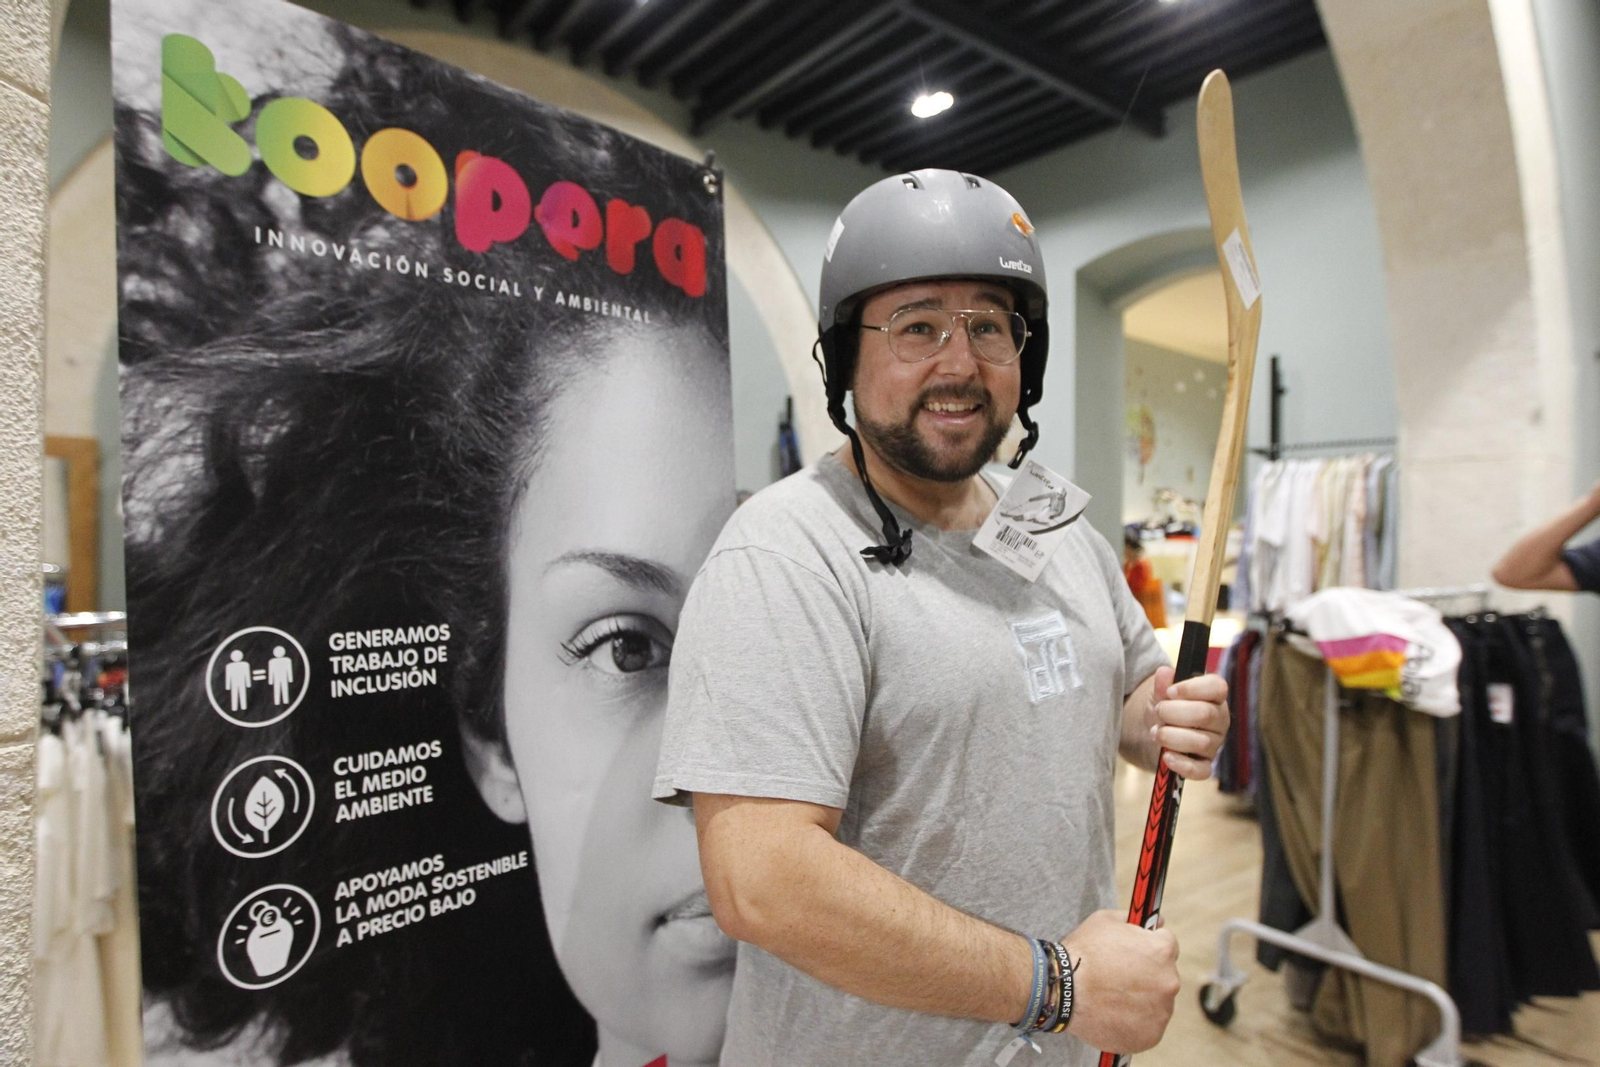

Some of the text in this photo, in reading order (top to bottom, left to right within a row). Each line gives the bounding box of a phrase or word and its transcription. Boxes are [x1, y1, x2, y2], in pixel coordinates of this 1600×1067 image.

[254, 226, 651, 324] INNOVACIÓN SOCIAL Y AMBIENTAL
[328, 623, 451, 651] GENERAMOS
[329, 645, 448, 674] TRABAJO DE
[330, 667, 438, 699] INCLUSIÓN
[333, 740, 443, 776] CUIDAMOS
[334, 765, 427, 800] EL MEDIO
[335, 785, 434, 823] AMBIENTE
[334, 854, 445, 901] APOYAMOS
[335, 850, 528, 925] LA MODA SOSTENIBLE
[336, 888, 477, 948] A PRECIO BAJO
[1061, 969, 1072, 1018] RENDIRSE
